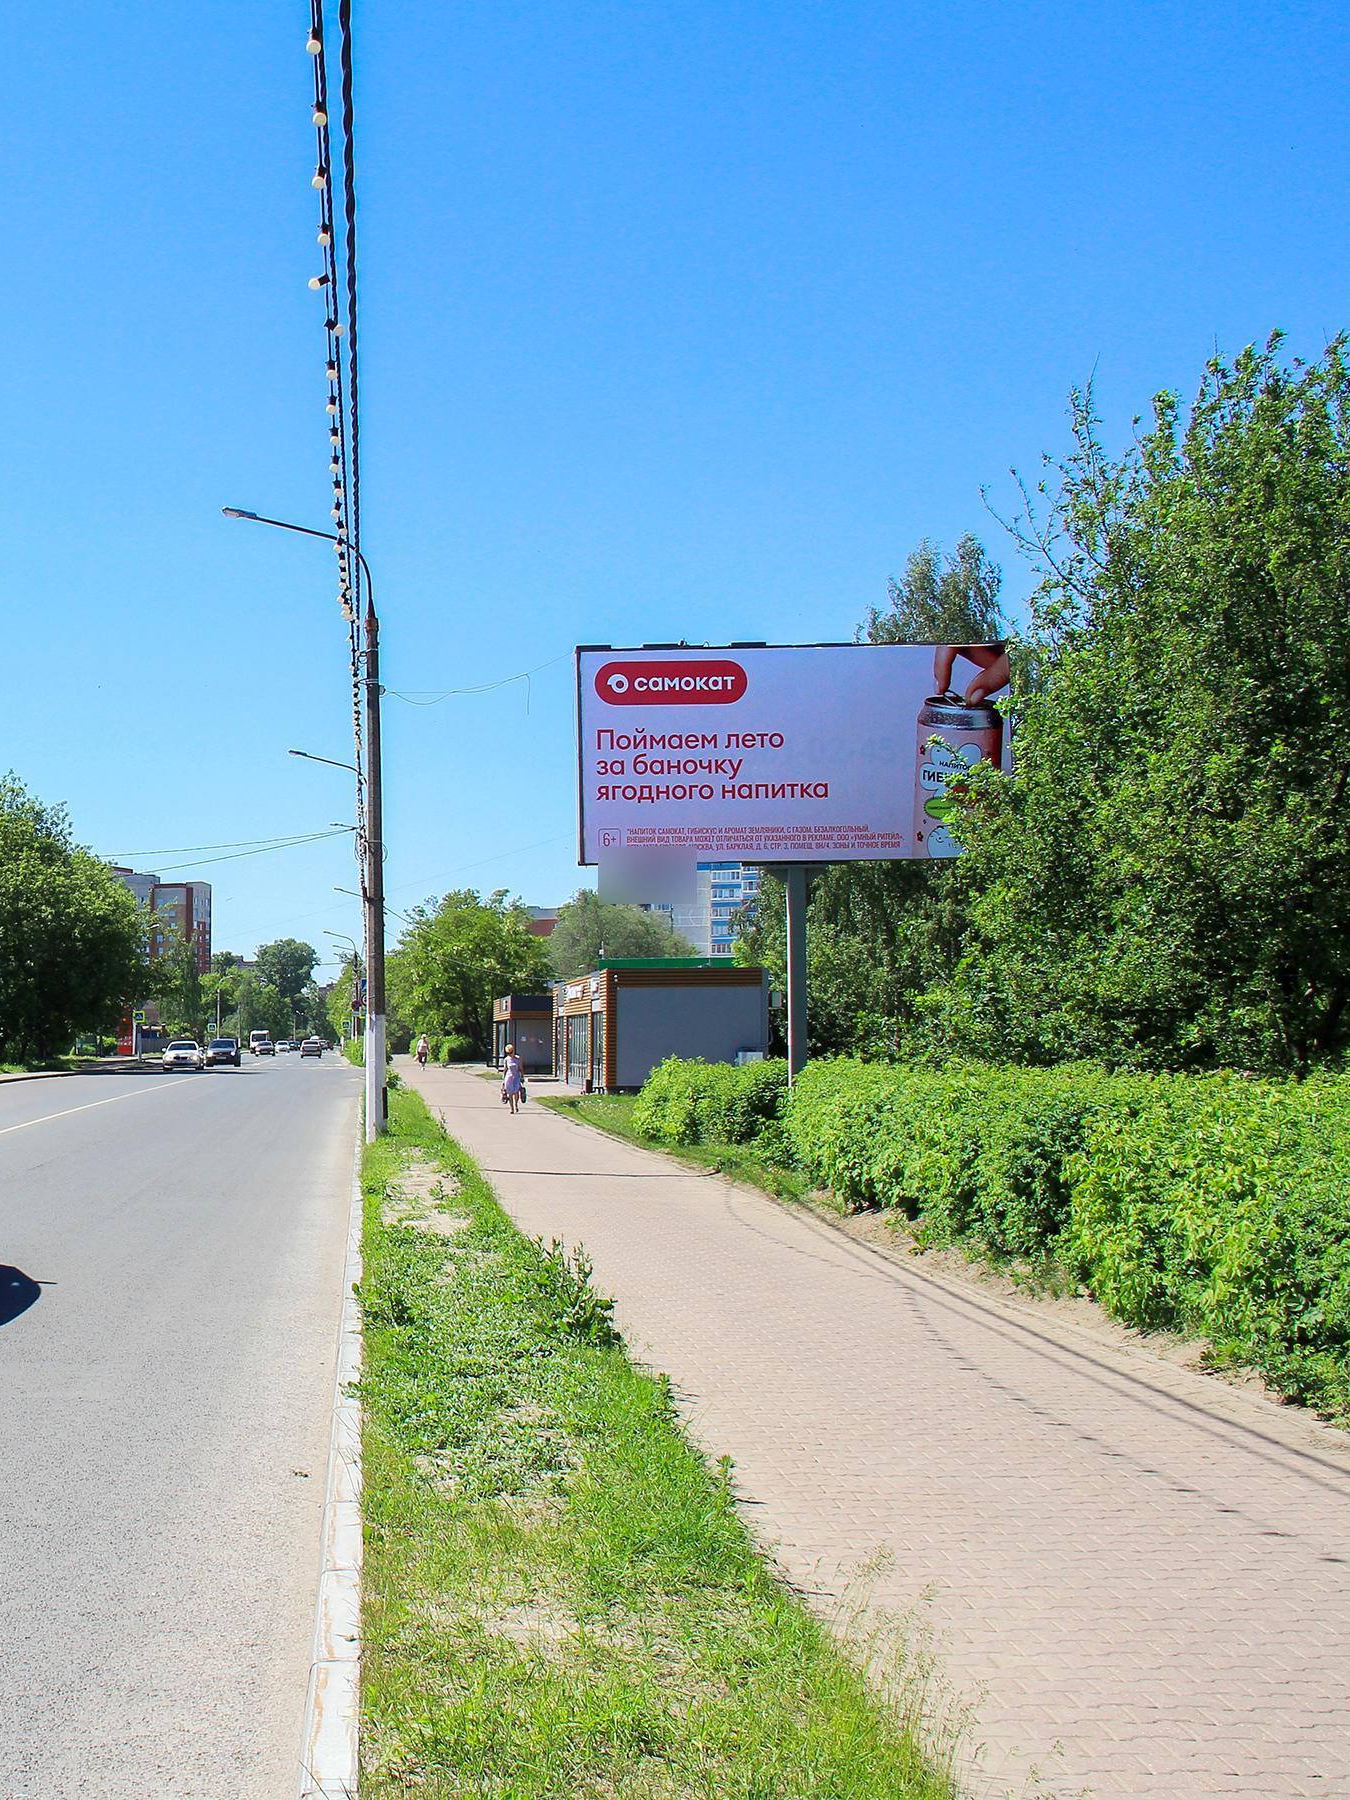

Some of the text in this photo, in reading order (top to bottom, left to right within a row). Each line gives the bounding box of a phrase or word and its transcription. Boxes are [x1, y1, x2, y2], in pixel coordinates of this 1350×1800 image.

[634, 675, 735, 692] самокат
[596, 727, 785, 751] Поймаем лето
[596, 753, 744, 780] за баночку
[939, 760, 970, 771] НАПИТО
[596, 782, 829, 804] ягодного напитка
[724, 826, 747, 834] АРОМАТ
[602, 832, 617, 847] 6+
[626, 835, 656, 844] ВНЕШНИЙ
[657, 836, 670, 844] ВИД
[671, 835, 693, 843] ТОВАРА
[694, 835, 714, 843] МОЖЕТ
[716, 835, 754, 843] ОТЛИЧАТЬСЯ
[754, 834, 762, 842] ОТ
[763, 834, 801, 843] УКАЗАННОГО
[836, 833, 850, 841] ООО
[880, 840, 901, 849] ВРЕМЯ
